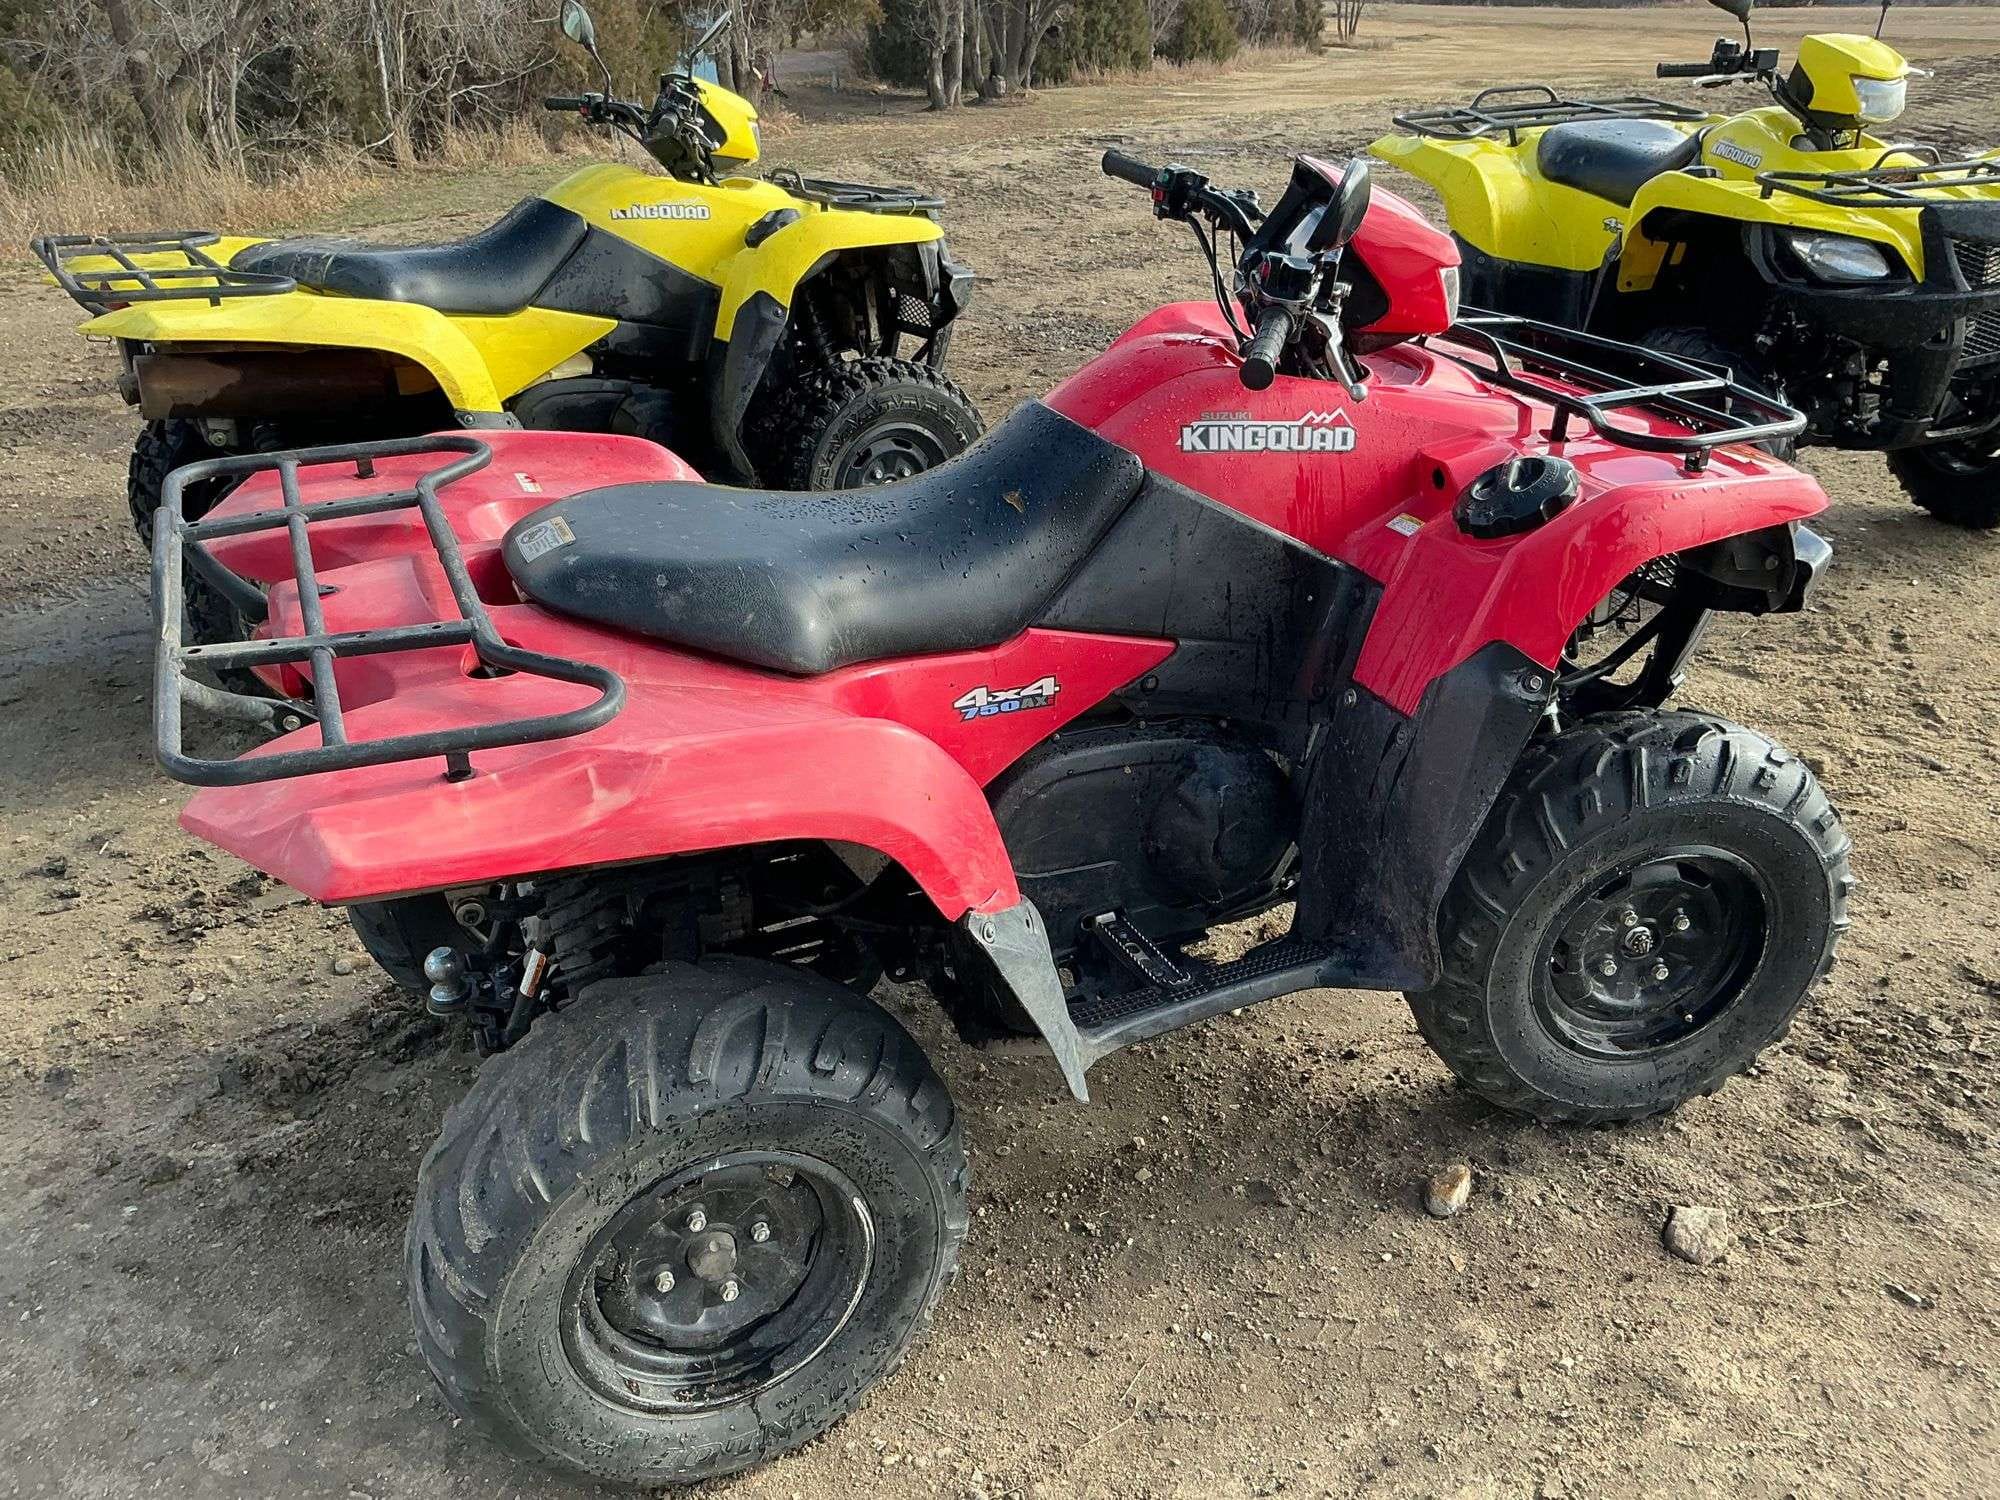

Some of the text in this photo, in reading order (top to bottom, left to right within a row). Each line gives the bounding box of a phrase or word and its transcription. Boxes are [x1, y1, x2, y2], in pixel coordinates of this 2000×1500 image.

[610, 203, 710, 220] KINGQUAD
[1200, 412, 1252, 421] SUZUKI
[1180, 424, 1357, 453] KINGQUAD
[952, 676, 1061, 709] 4x4
